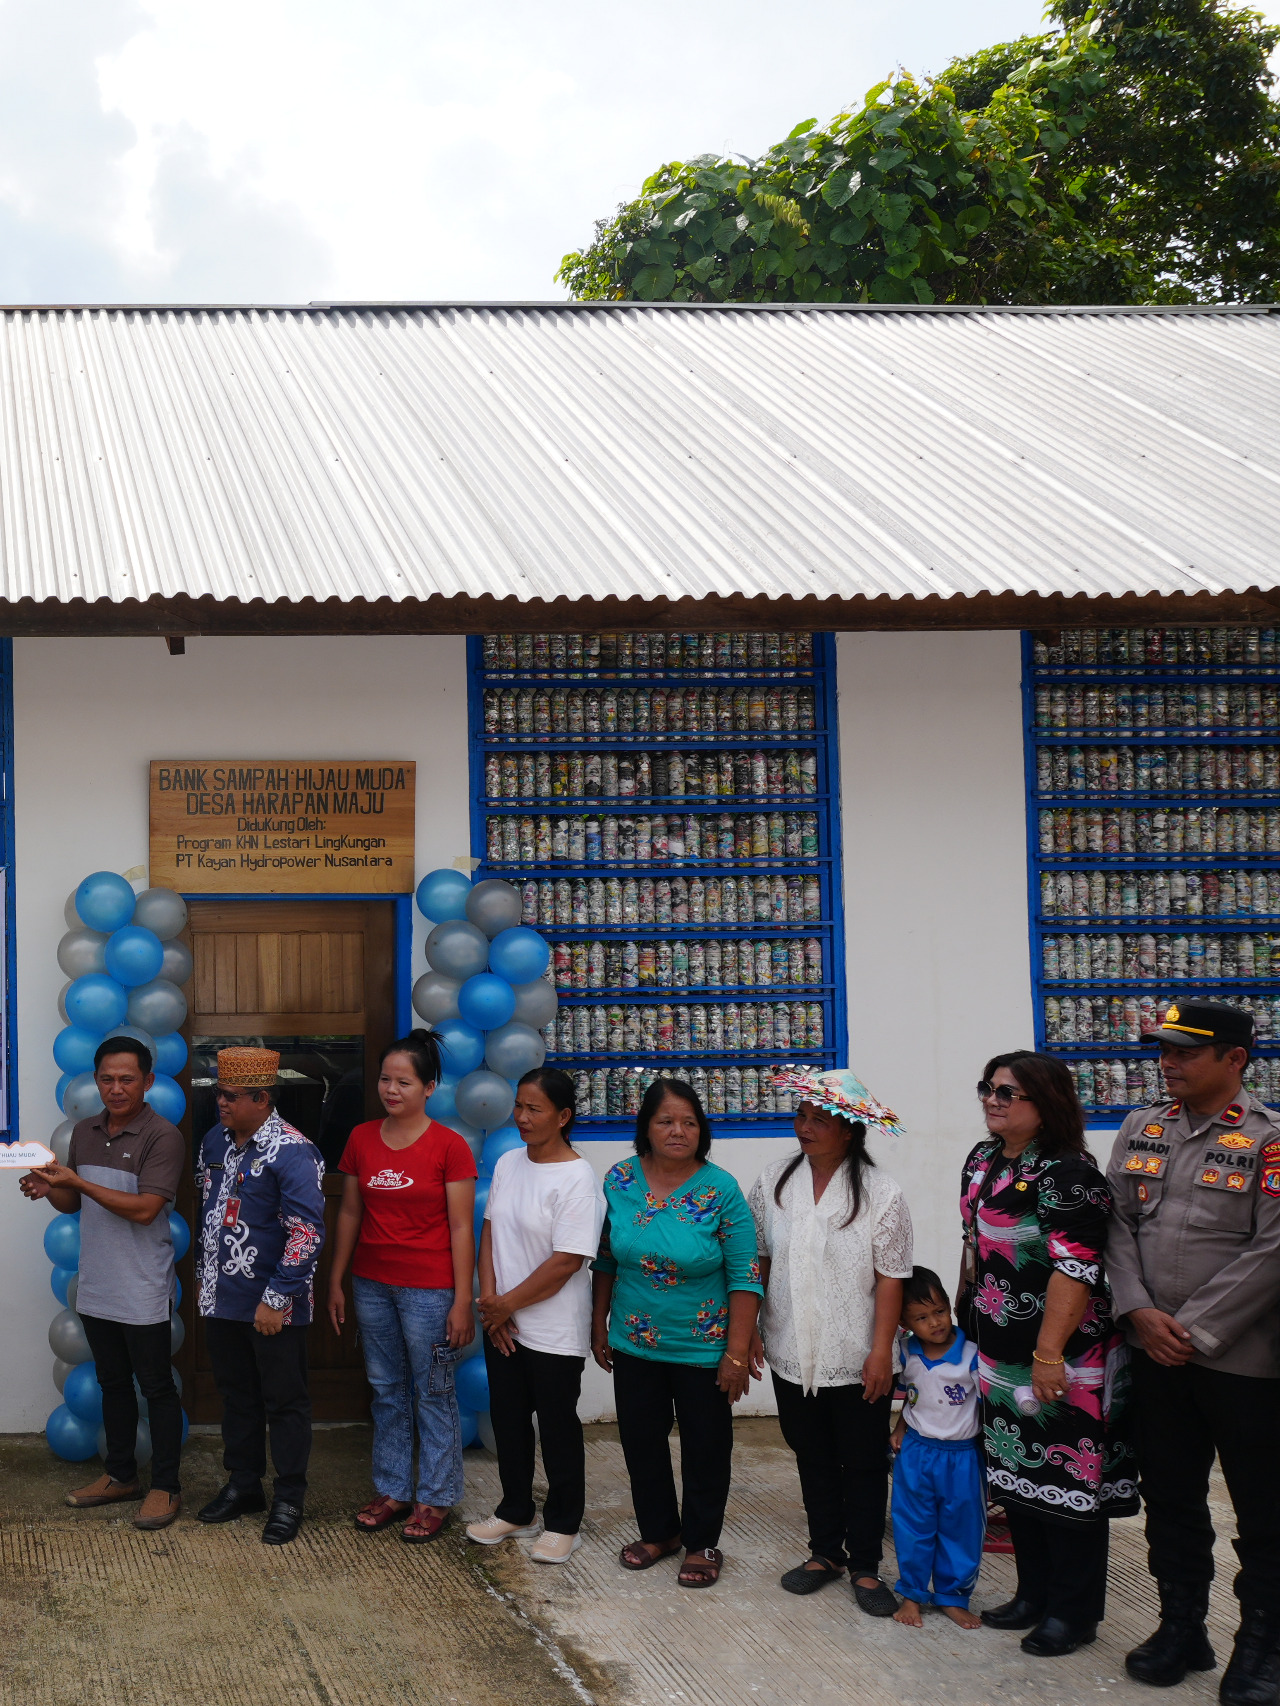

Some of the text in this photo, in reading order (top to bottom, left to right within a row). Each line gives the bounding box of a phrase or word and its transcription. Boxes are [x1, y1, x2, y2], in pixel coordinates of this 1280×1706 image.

[159, 768, 208, 791] BANK
[213, 768, 289, 791] SAMPAH
[186, 792, 384, 815] DESA HARAPAN MAJU
[296, 817, 326, 832] Oleh:
[177, 835, 231, 851] Program
[236, 835, 259, 849] KHN
[264, 835, 310, 849] Lestari
[176, 854, 192, 868] PT
[198, 854, 236, 870] Kayan
[325, 854, 393, 867] Nusantara
[1204, 1151, 1255, 1169] POLRI
